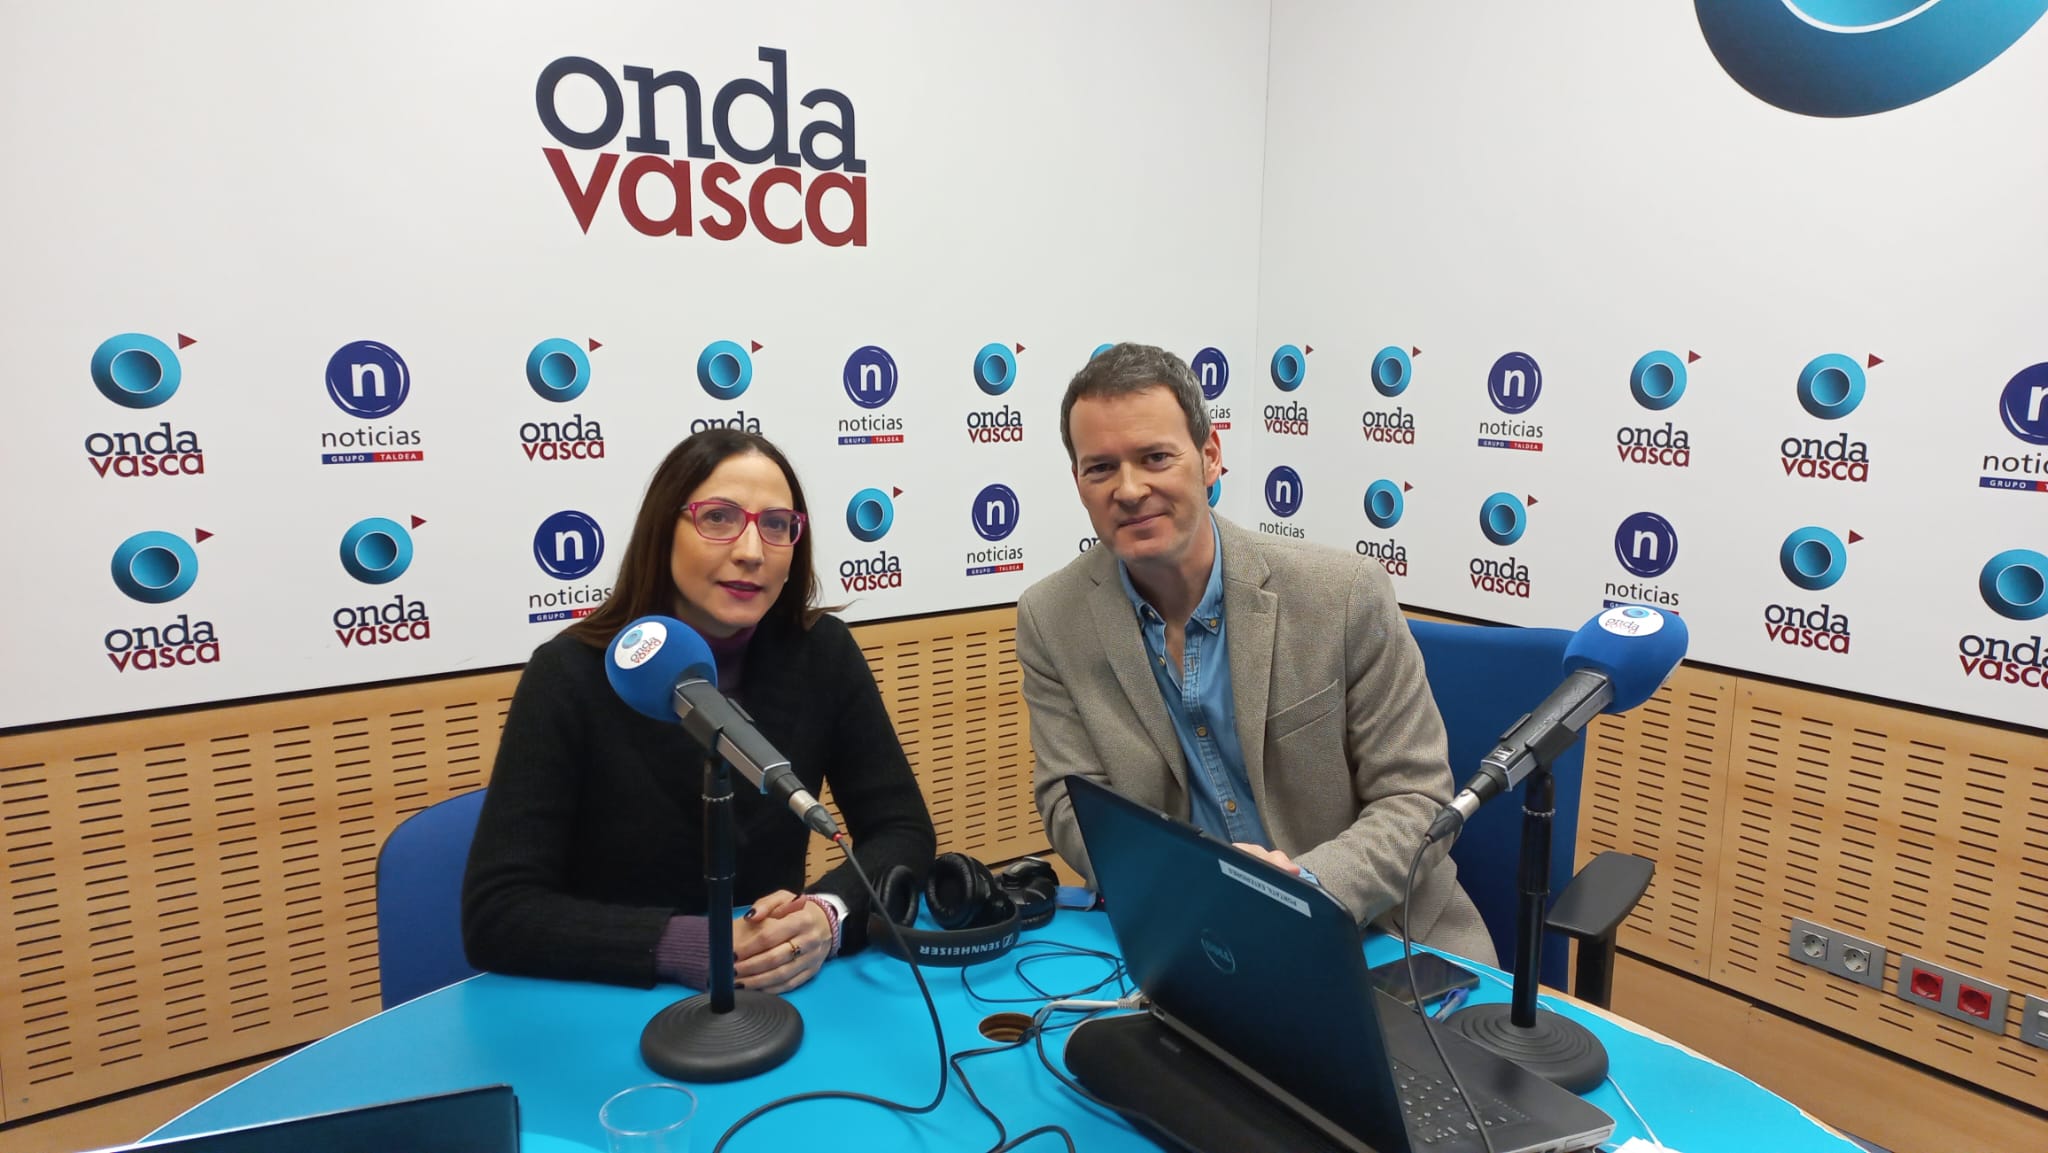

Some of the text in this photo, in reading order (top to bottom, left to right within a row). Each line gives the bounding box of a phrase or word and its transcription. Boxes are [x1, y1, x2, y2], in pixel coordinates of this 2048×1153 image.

[536, 47, 866, 173] onda
[542, 147, 867, 247] vasca
[966, 405, 1023, 428] onda
[1264, 401, 1308, 421] onda
[1362, 407, 1415, 430] onda
[520, 414, 604, 442] onda
[691, 411, 763, 436] onda
[839, 414, 903, 432] noticias
[967, 425, 1023, 443] vasca
[1264, 419, 1308, 435] vasca
[1479, 420, 1543, 438] noticias
[85, 422, 202, 455] onda
[322, 426, 421, 448] noticias
[1363, 427, 1415, 444] vasca
[1616, 422, 1690, 449] onda
[521, 440, 605, 461] vasca
[1617, 445, 1690, 467] vasca
[1780, 433, 1869, 463] onda
[88, 452, 204, 479] vasca
[1781, 457, 1868, 482] vasca
[1989, 480, 2026, 488] GRUPO
[1259, 521, 1305, 539] noticias
[967, 545, 1023, 564] noticias
[1356, 539, 1407, 562] onda
[839, 551, 902, 578] onda
[1469, 557, 1530, 582] onda
[840, 572, 902, 593] vasca
[1470, 573, 1530, 598] vasca
[1604, 582, 1679, 606] noticias
[529, 585, 612, 608] noticias
[333, 595, 429, 628] onda
[536, 612, 565, 621] GRUPO
[1764, 604, 1850, 635] onda
[104, 614, 218, 652] onda
[335, 620, 431, 648] vasca
[1765, 622, 1850, 654] vasca
[107, 642, 220, 673] vasca
[920, 941, 1000, 955] SENNHEISER
